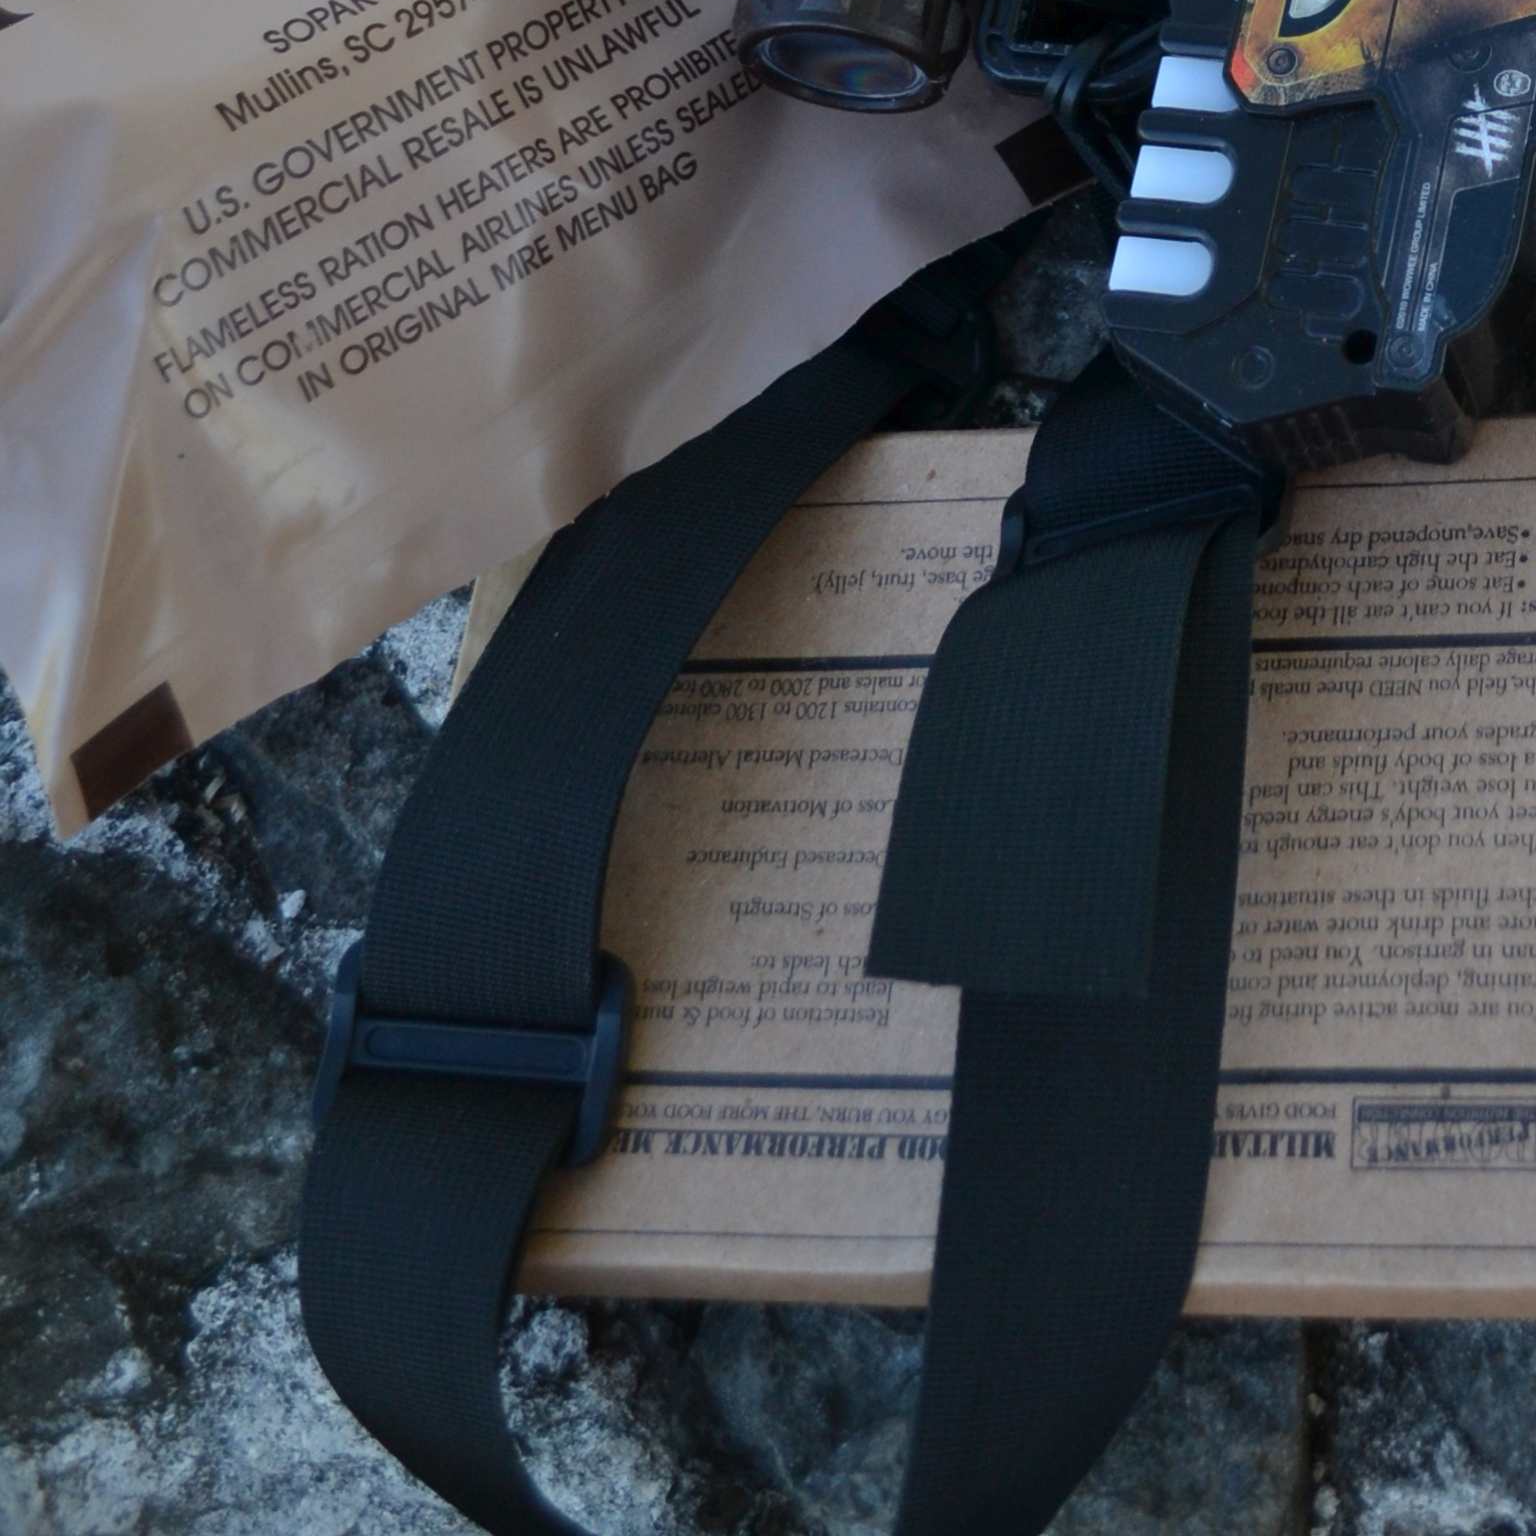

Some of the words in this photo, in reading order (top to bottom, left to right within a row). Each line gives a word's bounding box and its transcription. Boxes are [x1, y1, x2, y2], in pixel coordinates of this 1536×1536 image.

[213, 56, 351, 133] Mullins,
[343, 22, 396, 64] SC
[181, 184, 251, 236] U.S.
[251, 49, 486, 196] GOVERNMENT
[151, 154, 404, 308] COMMERCIAL
[400, 88, 517, 171] RESALE
[512, 74, 544, 110] IS
[150, 271, 317, 385] FLAMELESS
[317, 203, 436, 287] RATION
[435, 137, 557, 221] HEATERS
[557, 104, 614, 156] ARE
[609, 28, 748, 121] PROHIBITE
[180, 372, 235, 424] ON
[460, 173, 579, 265] AIRLINES
[577, 117, 676, 190] UNLESS
[296, 362, 336, 404] IN
[339, 277, 492, 376] ORIGINAL
[489, 233, 555, 291] MRE
[554, 184, 639, 252] MENU
[638, 151, 699, 203] BAG
[1281, 721, 1417, 747] performance.
[1422, 721, 1469, 742] your
[735, 748, 803, 770] Mental
[1287, 755, 1326, 778] and
[1332, 754, 1388, 777] fluids
[1394, 749, 1445, 776] body
[1451, 752, 1472, 774] of
[1477, 751, 1517, 771] loss
[1297, 781, 1334, 798] can
[1339, 780, 1384, 802] This
[1392, 775, 1469, 800] weight.
[1476, 776, 1516, 799] lose
[720, 799, 826, 819] Motivation
[1267, 832, 1342, 861] enough
[1348, 835, 1380, 852] eat
[1386, 833, 1441, 855] don't
[1447, 829, 1486, 849] you
[729, 897, 812, 924] Strength
[818, 901, 838, 924] of
[705, 1006, 751, 1028] food
[754, 1007, 776, 1030] of
[782, 1007, 890, 1029] Restriction
[1283, 1103, 1337, 1120] FOOD
[664, 1129, 888, 1161] PERFORMANCE
